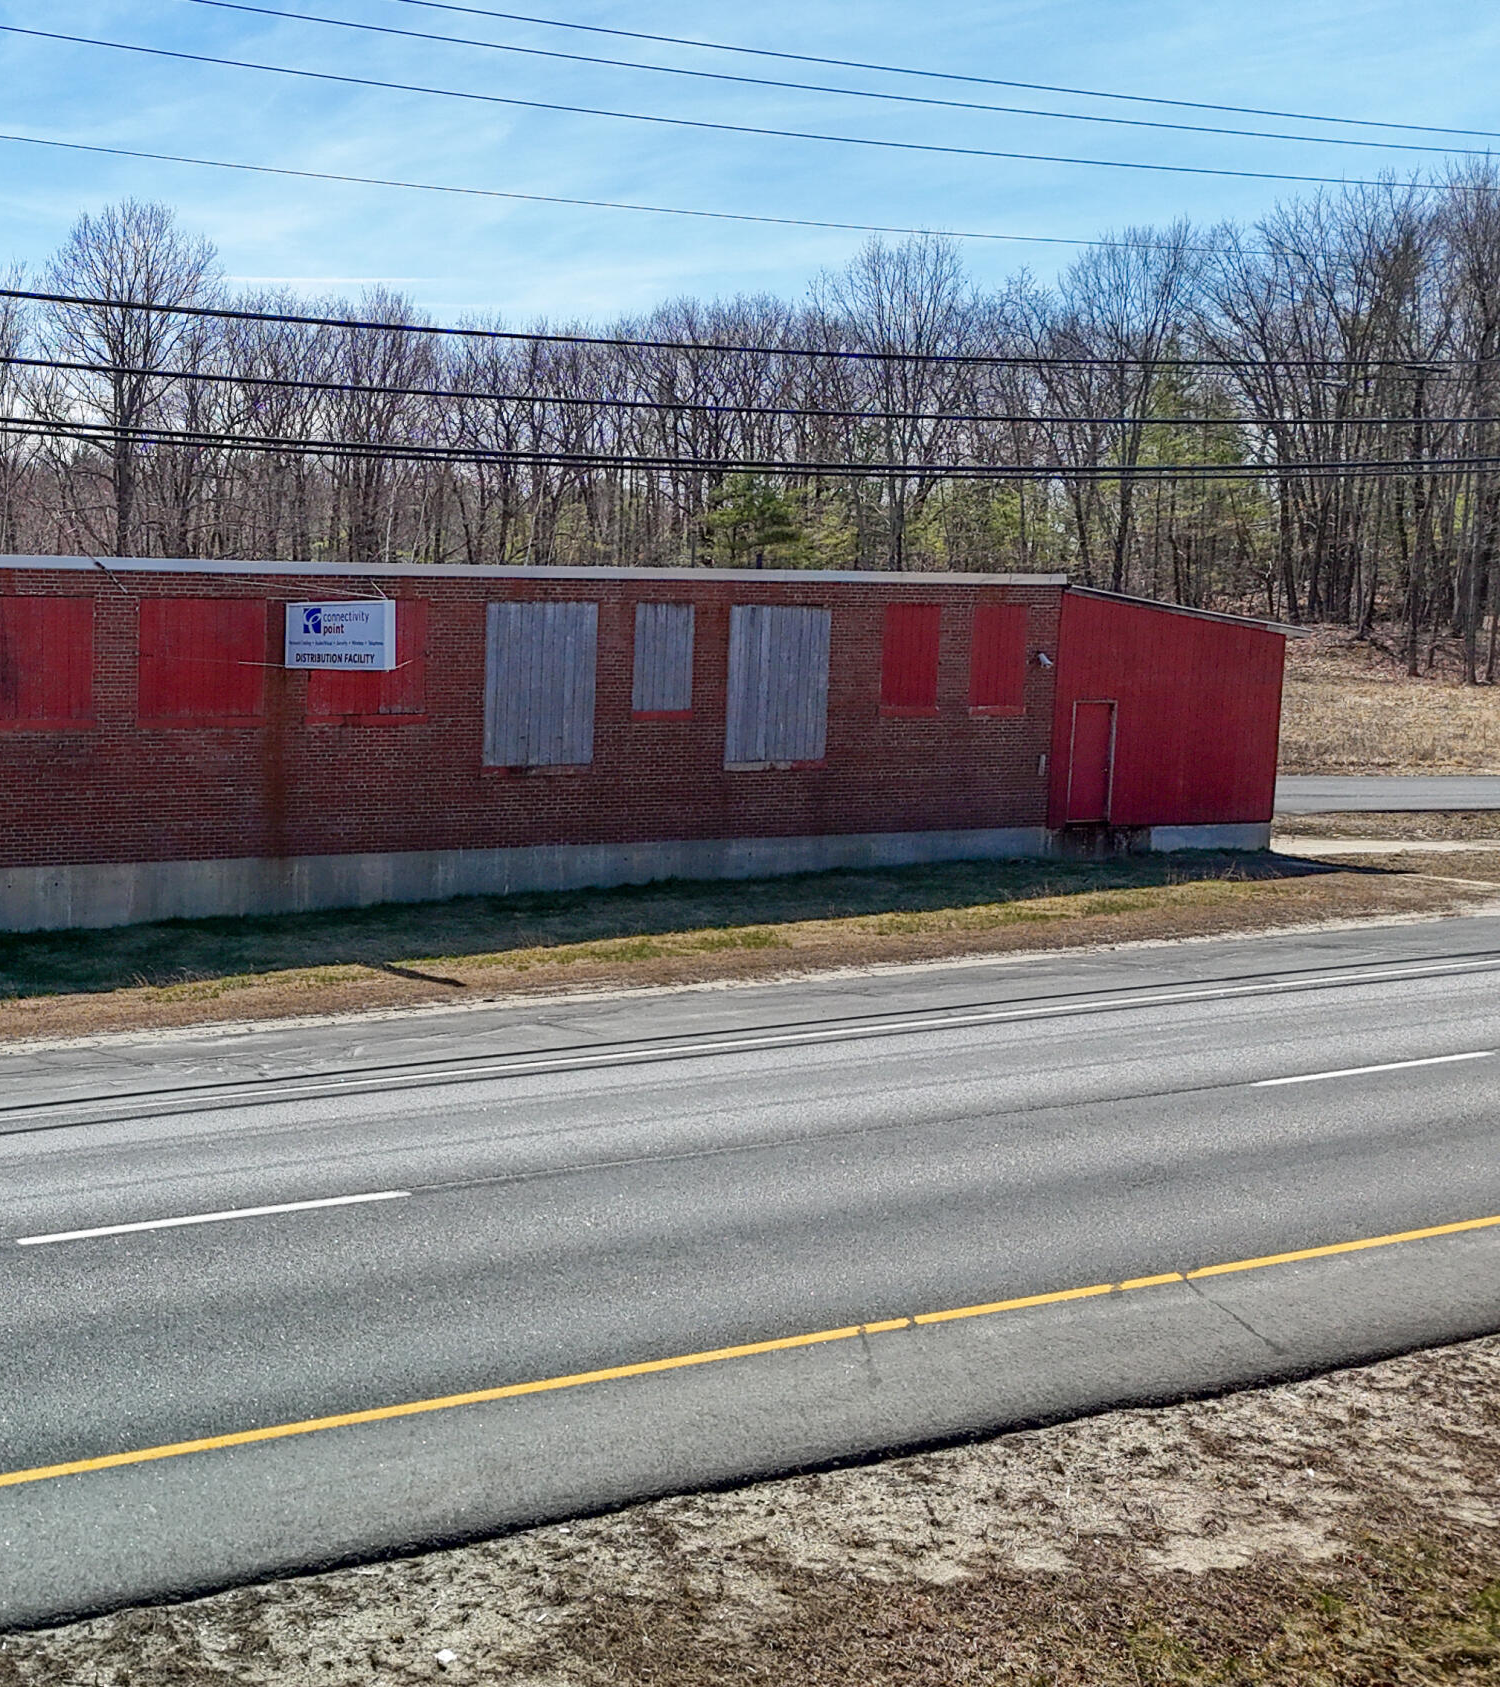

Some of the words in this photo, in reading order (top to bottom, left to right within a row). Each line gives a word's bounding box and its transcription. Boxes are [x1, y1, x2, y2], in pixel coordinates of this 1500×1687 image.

[323, 611, 369, 624] connectivity
[323, 624, 344, 635] point
[296, 653, 342, 663] DISTRIBUTION
[344, 653, 375, 663] FACILITY
